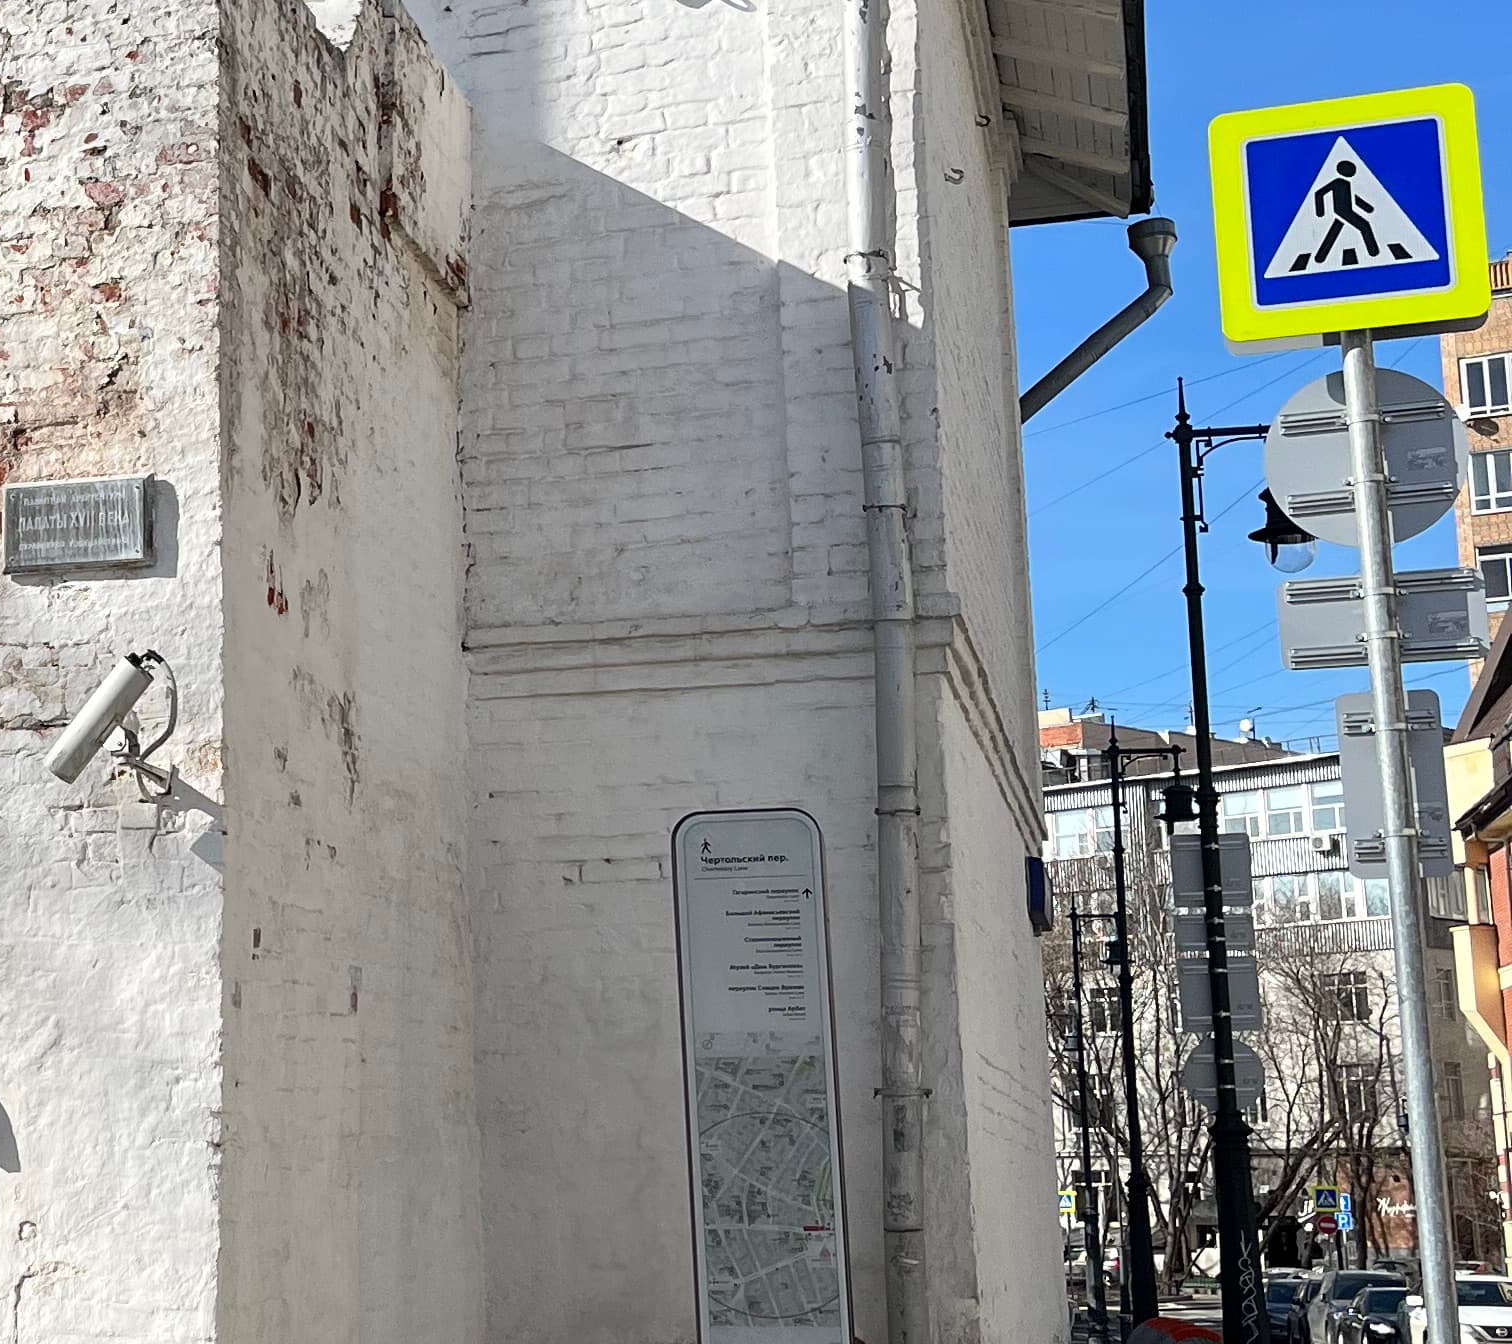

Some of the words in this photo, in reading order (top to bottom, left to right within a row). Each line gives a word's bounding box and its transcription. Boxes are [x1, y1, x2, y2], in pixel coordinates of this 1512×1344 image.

[18, 514, 66, 531] ПАЛАТЫ
[700, 853, 765, 866] Чертольский
[767, 854, 789, 864] пер.
